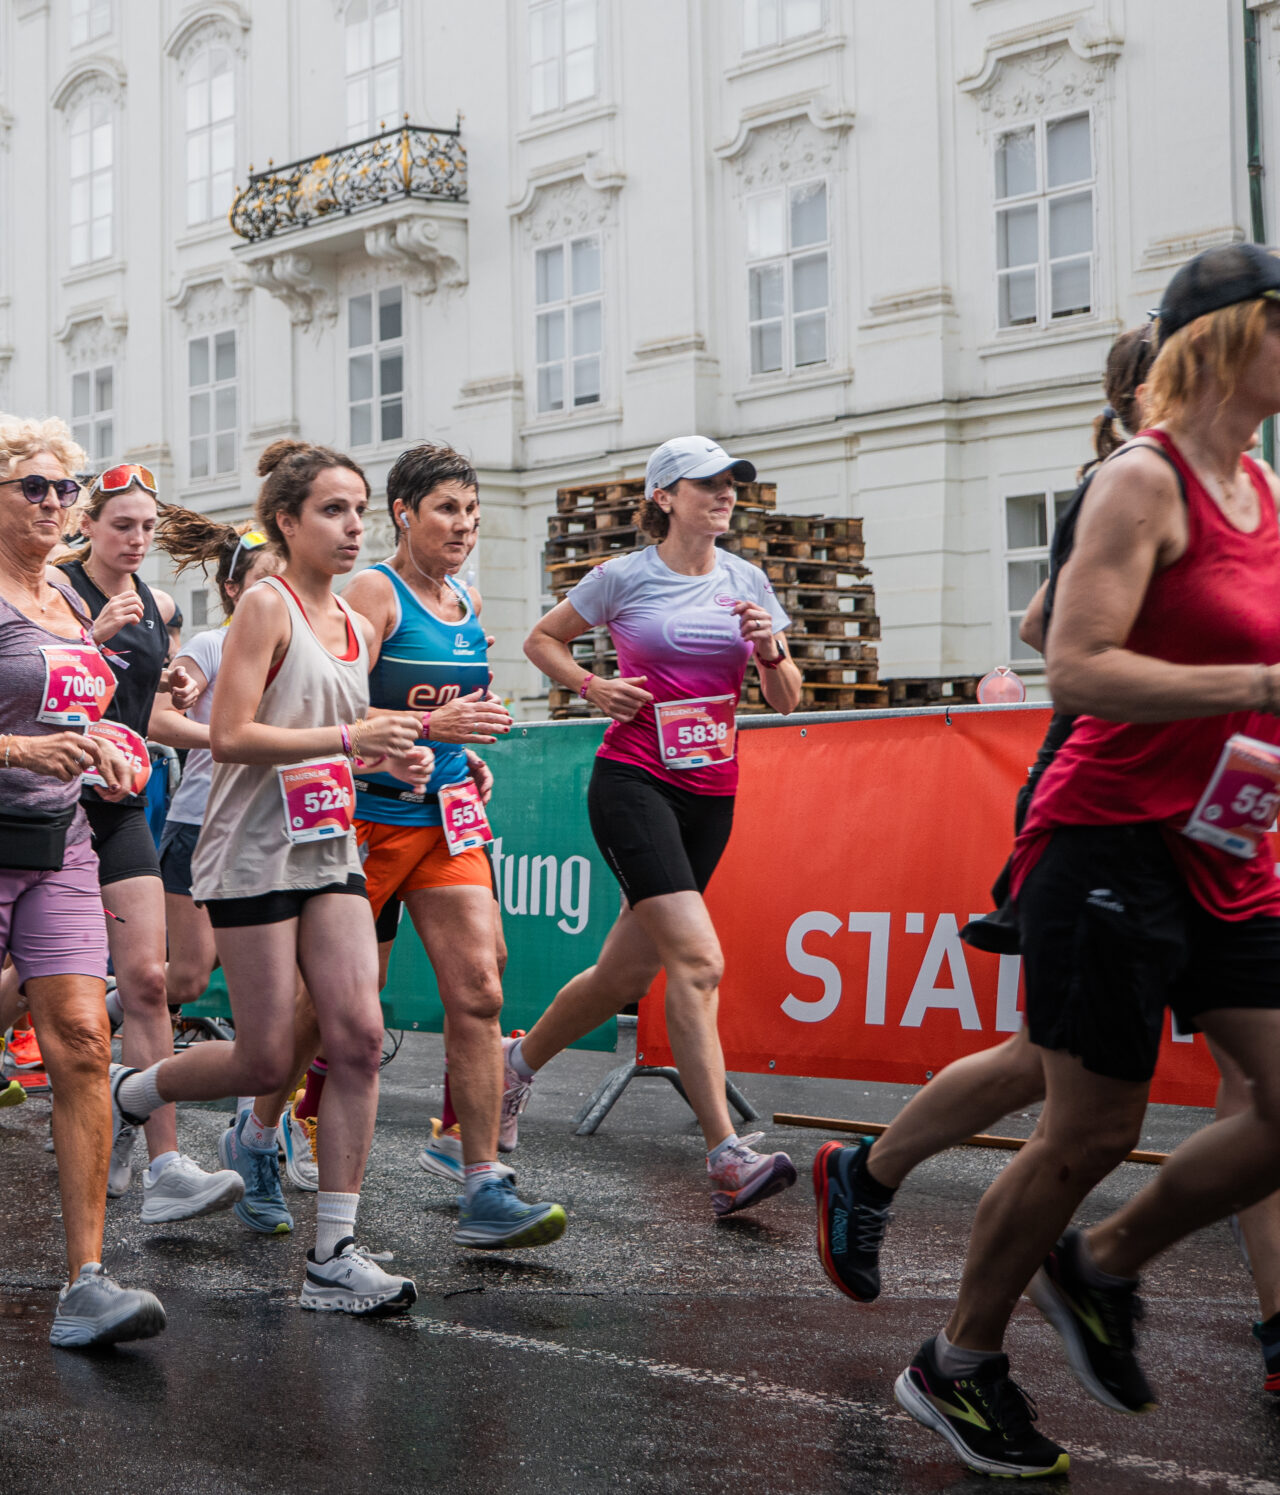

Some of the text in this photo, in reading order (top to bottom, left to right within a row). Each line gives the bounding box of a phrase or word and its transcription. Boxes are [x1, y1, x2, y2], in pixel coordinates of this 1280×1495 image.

[61, 675, 106, 697] 7060
[677, 722, 728, 744] 5838
[304, 786, 351, 813] 5226
[780, 910, 1022, 1032] STÄ
